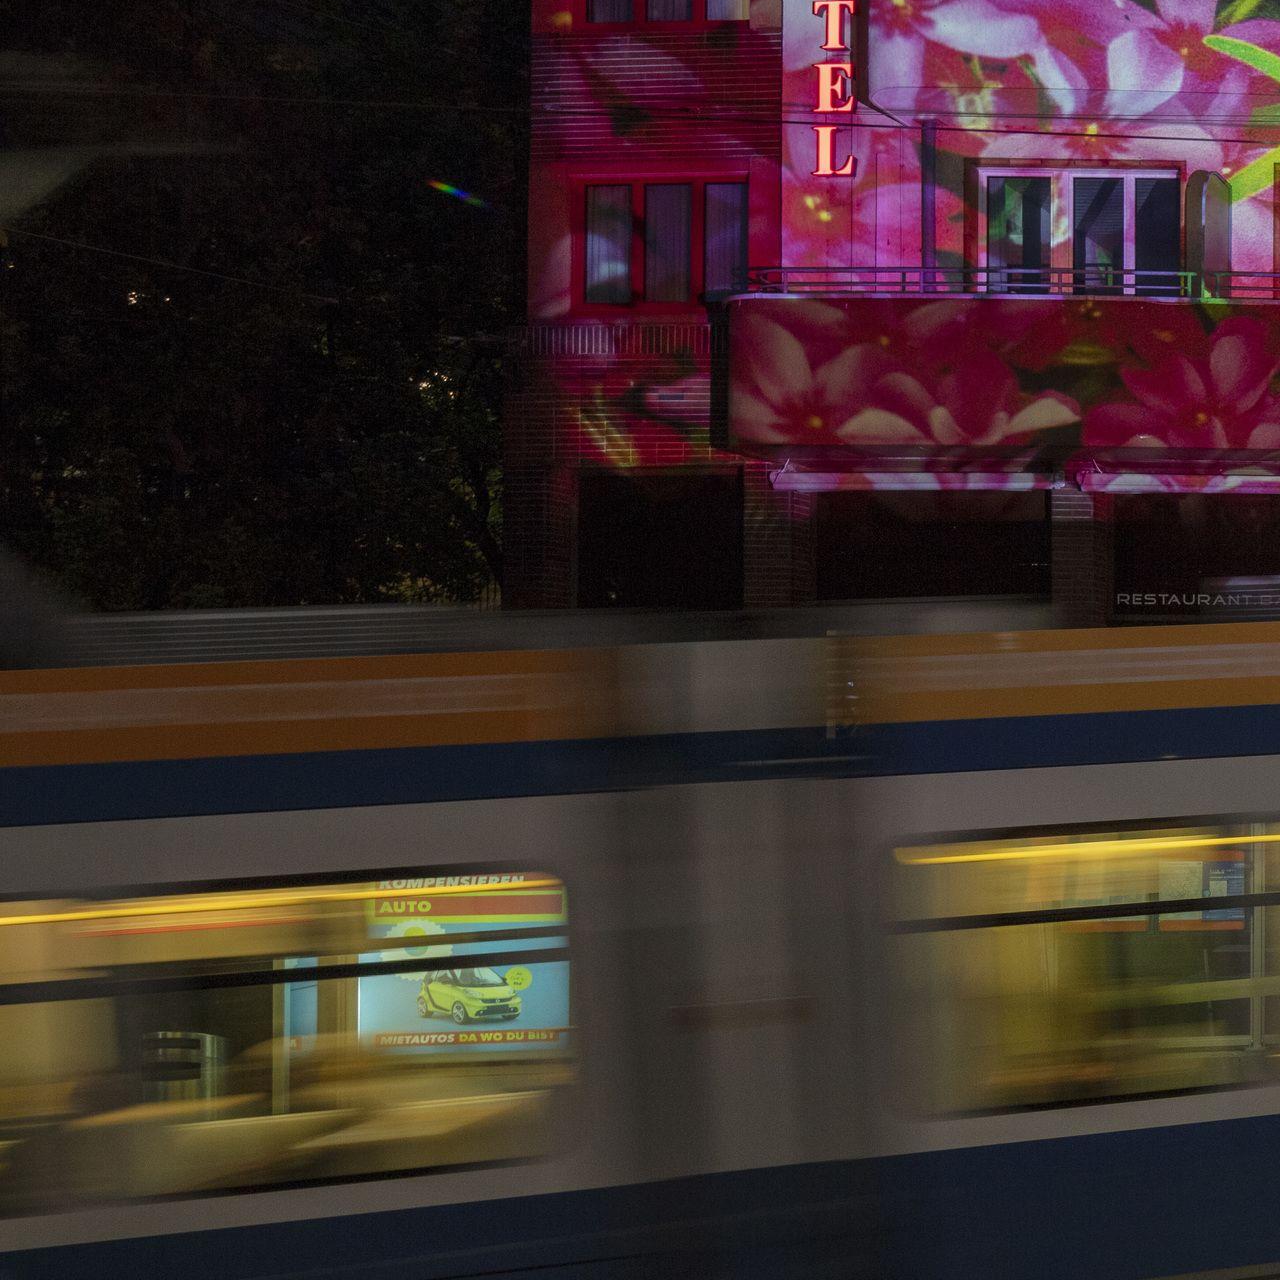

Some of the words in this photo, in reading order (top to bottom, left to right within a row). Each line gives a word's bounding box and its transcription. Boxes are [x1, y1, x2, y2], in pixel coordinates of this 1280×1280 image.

[379, 900, 433, 914] AUTO
[379, 1033, 456, 1046] MIETAUTOS
[458, 1032, 479, 1043] DA
[480, 1032, 504, 1042] WO
[506, 1031, 525, 1041] DU
